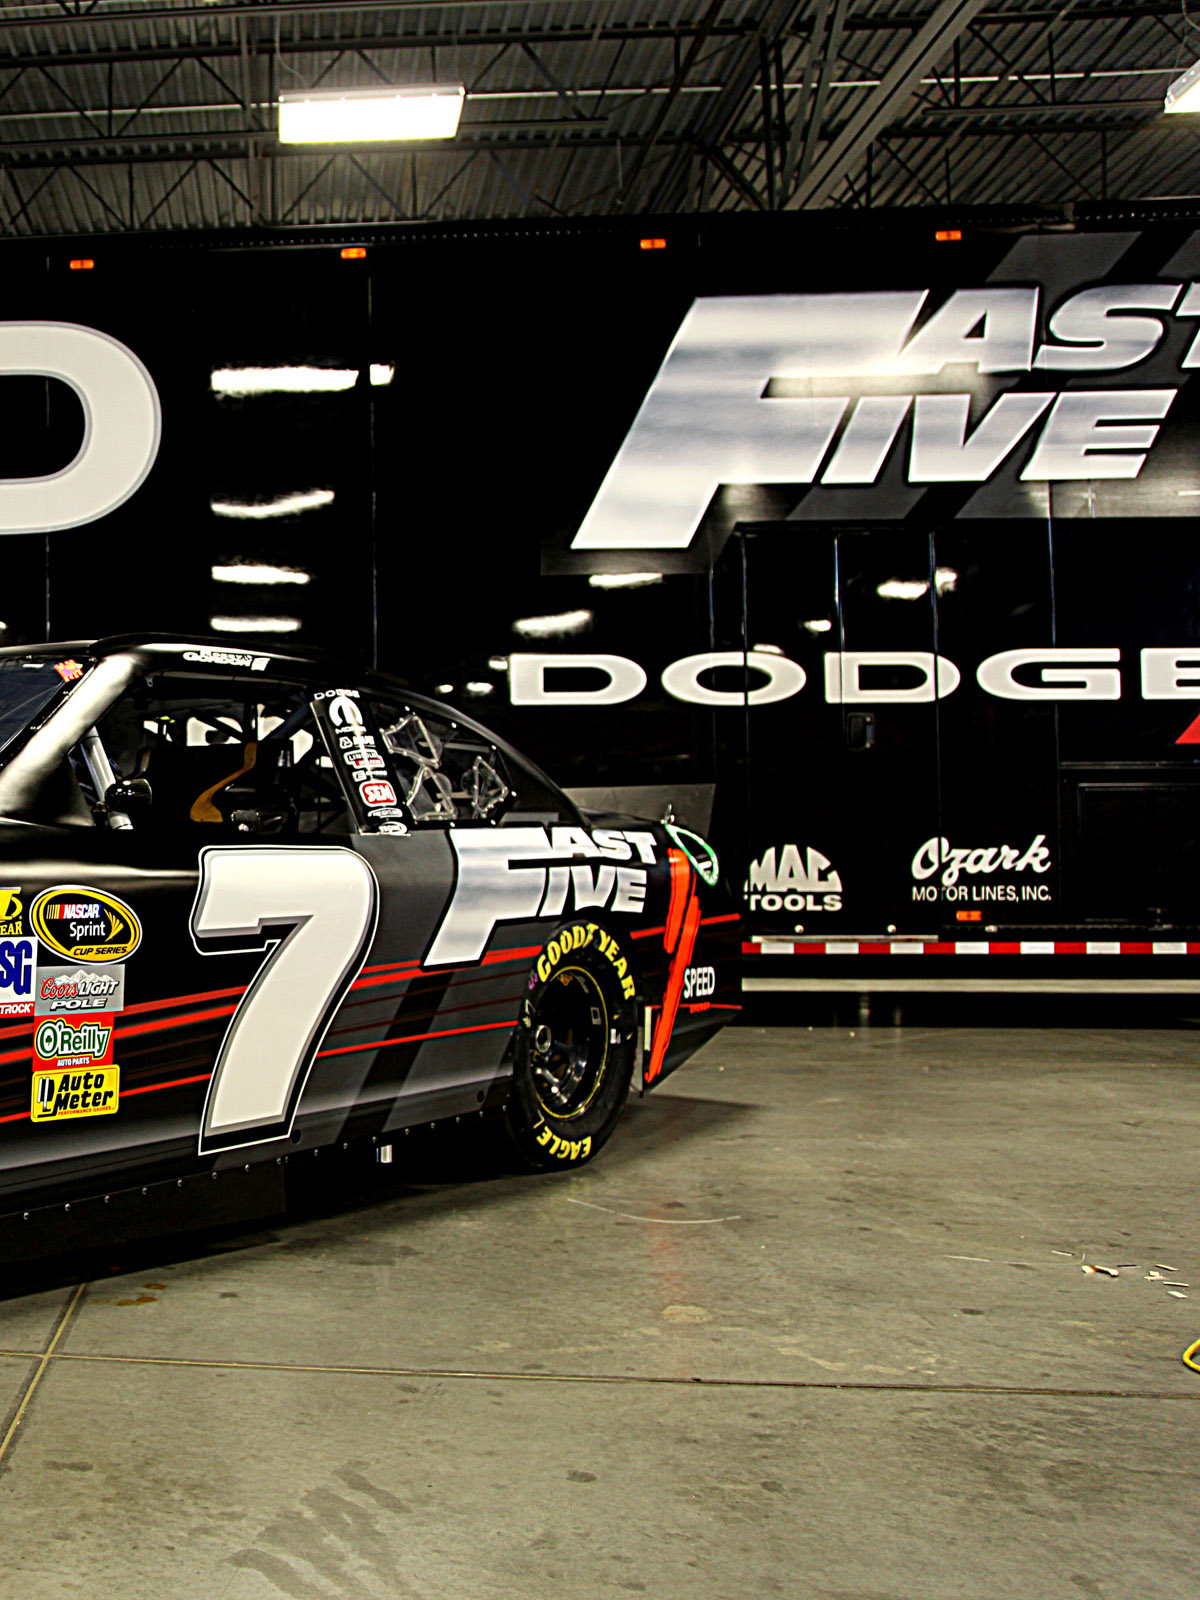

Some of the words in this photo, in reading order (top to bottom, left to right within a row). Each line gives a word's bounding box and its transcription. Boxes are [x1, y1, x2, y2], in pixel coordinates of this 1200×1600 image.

[743, 844, 843, 893] MAC
[911, 834, 1052, 887] Ozark
[743, 894, 843, 912] TOOLS
[972, 885, 1020, 903] LINES,
[1021, 885, 1052, 901] INC.
[64, 903, 101, 919] NASCAR
[69, 921, 106, 941] Sprint
[73, 946, 94, 956] CUP
[95, 945, 128, 955] SERIES
[536, 922, 636, 1001] GOODYEAR
[40, 977, 78, 1000] Coors
[78, 980, 119, 997] LIGHT
[683, 966, 716, 999] SPEED
[50, 998, 108, 1011] POLE
[189, 845, 380, 1156] 7
[39, 1021, 108, 1055] O'Reilly
[57, 1059, 71, 1067] AUTO
[72, 1057, 90, 1065] PARTS
[58, 1072, 105, 1093] Auto
[54, 1090, 114, 1112] Meter
[536, 1126, 592, 1160] EAGLE
